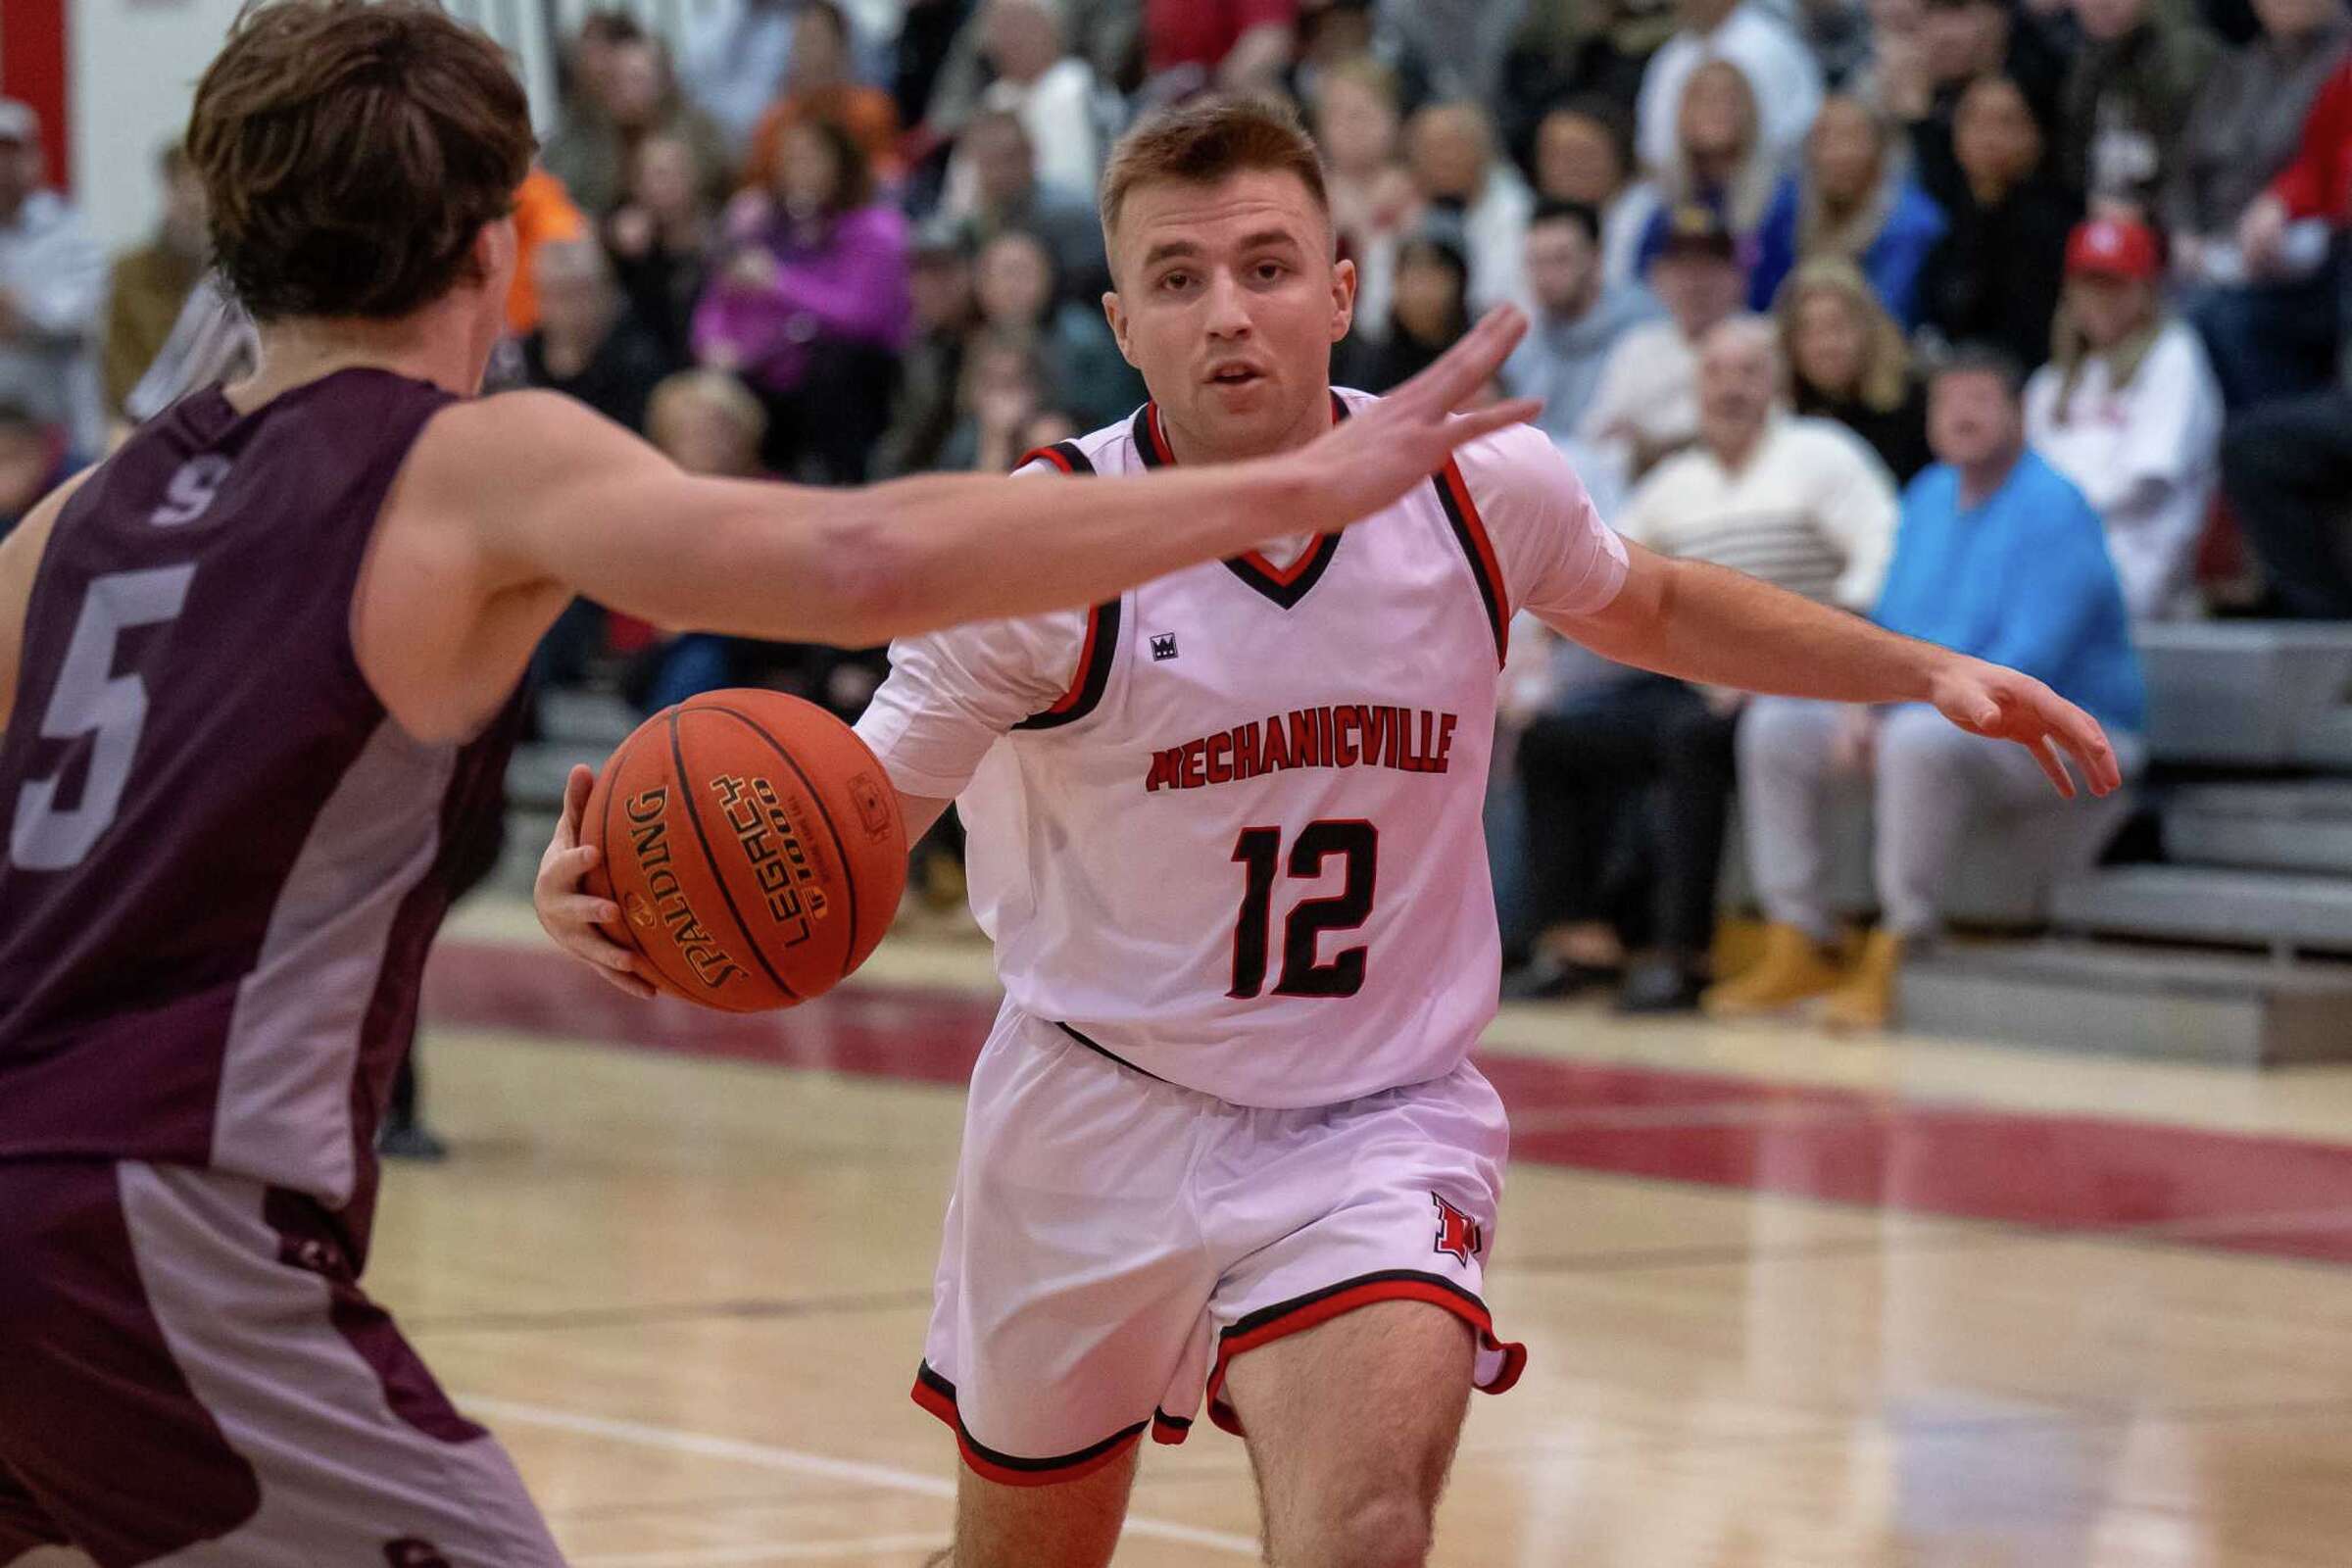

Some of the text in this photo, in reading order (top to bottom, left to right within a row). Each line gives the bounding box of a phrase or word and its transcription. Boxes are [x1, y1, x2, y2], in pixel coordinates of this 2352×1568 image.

[10, 562, 198, 871] 5
[1146, 705, 1457, 792] MECHANICVILLE
[624, 784, 749, 989] SPALDING
[710, 774, 809, 949] LEGACY
[1224, 818, 1379, 1000] 12
